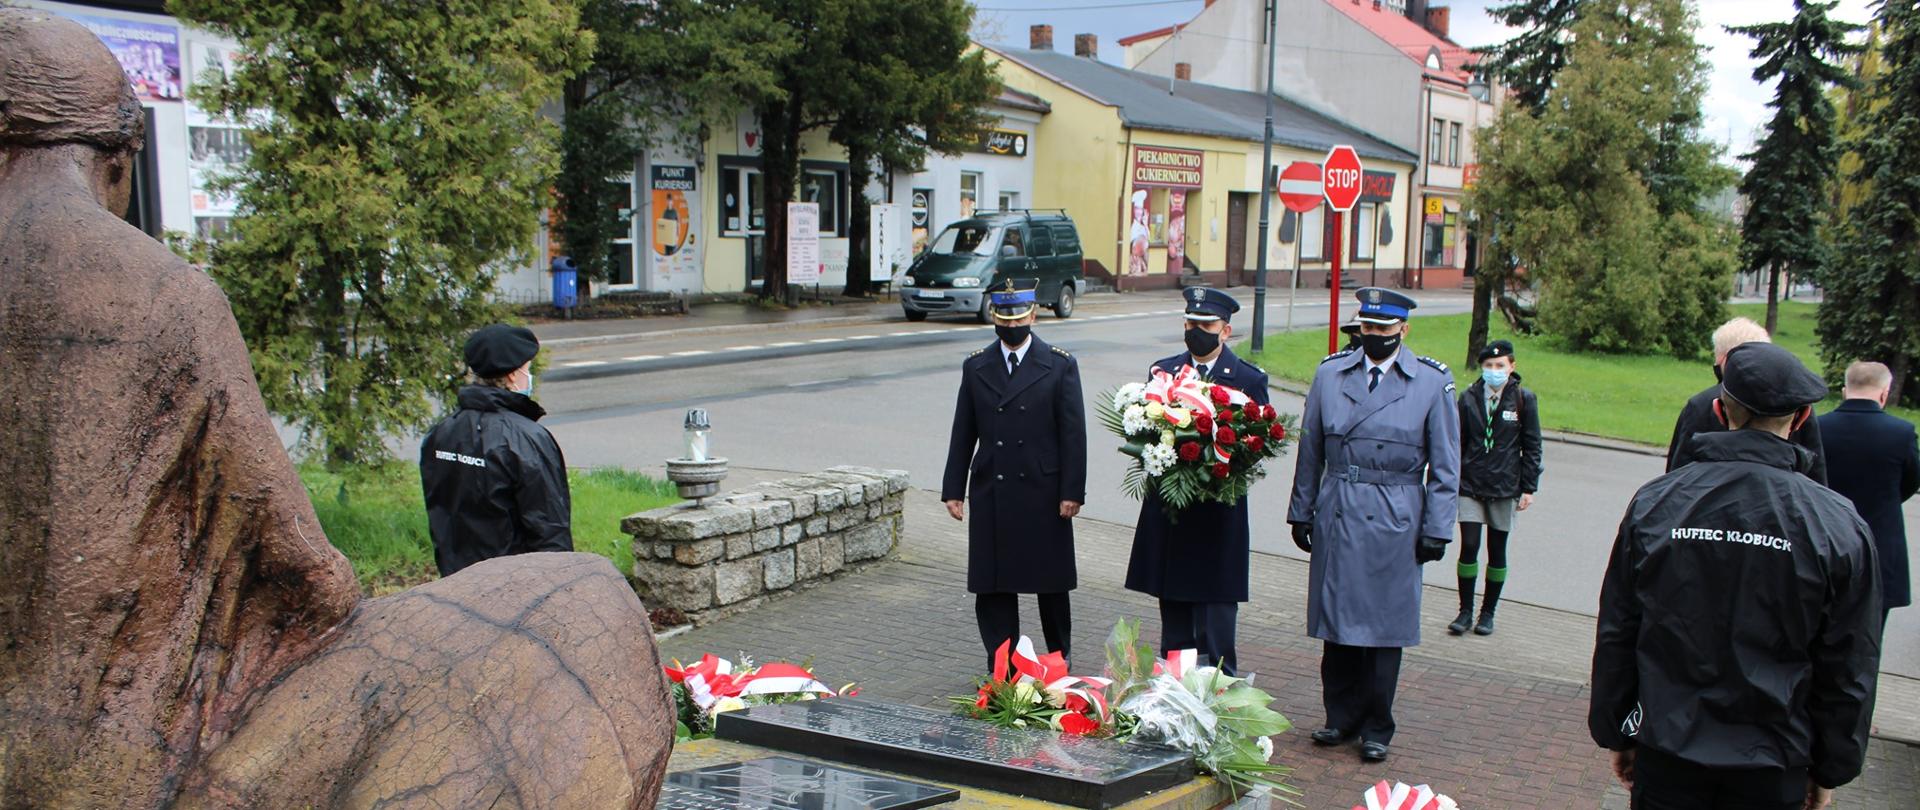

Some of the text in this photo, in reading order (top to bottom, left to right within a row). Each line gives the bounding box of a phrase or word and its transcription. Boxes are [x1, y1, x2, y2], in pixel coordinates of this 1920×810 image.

[1137, 150, 1200, 167] PIEKARNICTWO
[661, 167, 685, 178] PUNKT
[1136, 167, 1200, 184] CUKIERNICTWO
[1327, 168, 1358, 188] STOP
[655, 180, 692, 190] KURIERSKI
[1431, 200, 1438, 212] 5
[1671, 528, 1792, 552] HUFIEC KŁOBUCK
